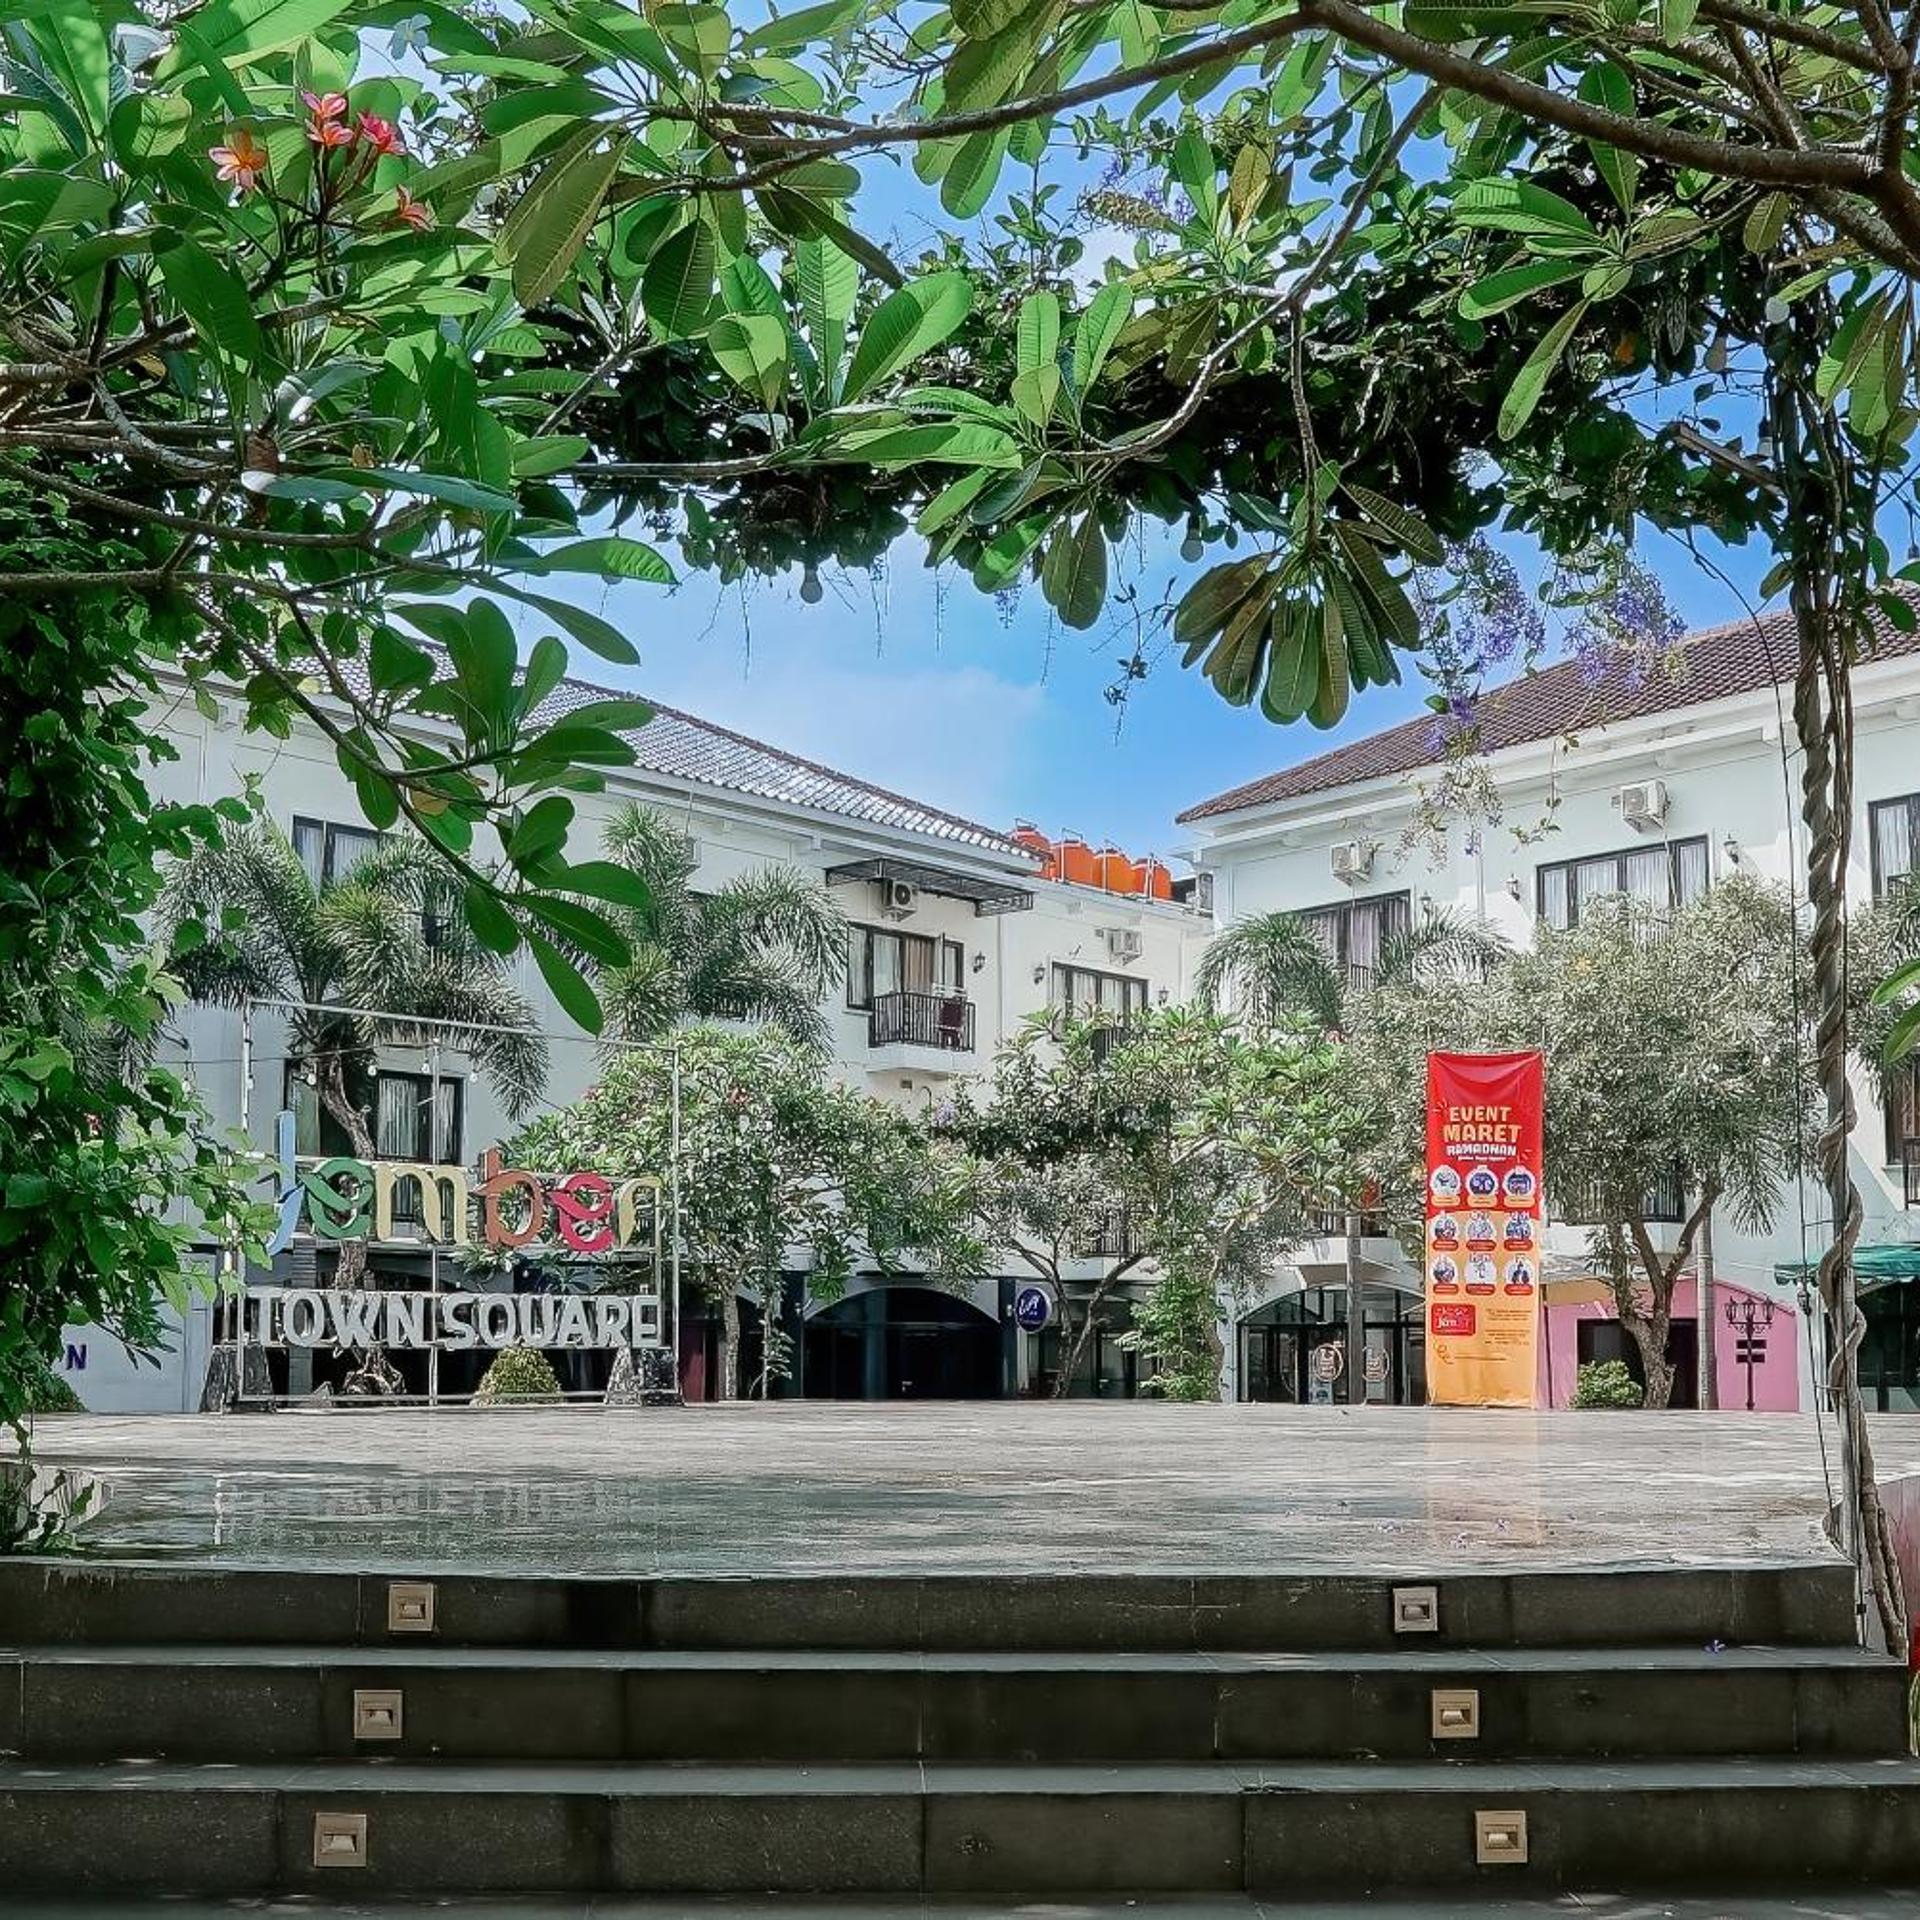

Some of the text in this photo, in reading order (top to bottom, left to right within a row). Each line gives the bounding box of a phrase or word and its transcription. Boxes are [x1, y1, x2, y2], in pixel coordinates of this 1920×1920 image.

[1449, 1106, 1512, 1122] EVENT
[1443, 1124, 1522, 1143] MARET
[1446, 1143, 1517, 1157] RAMADHAN
[260, 1110, 662, 1257] Jember
[250, 1290, 663, 1350] TOWN SQUARE
